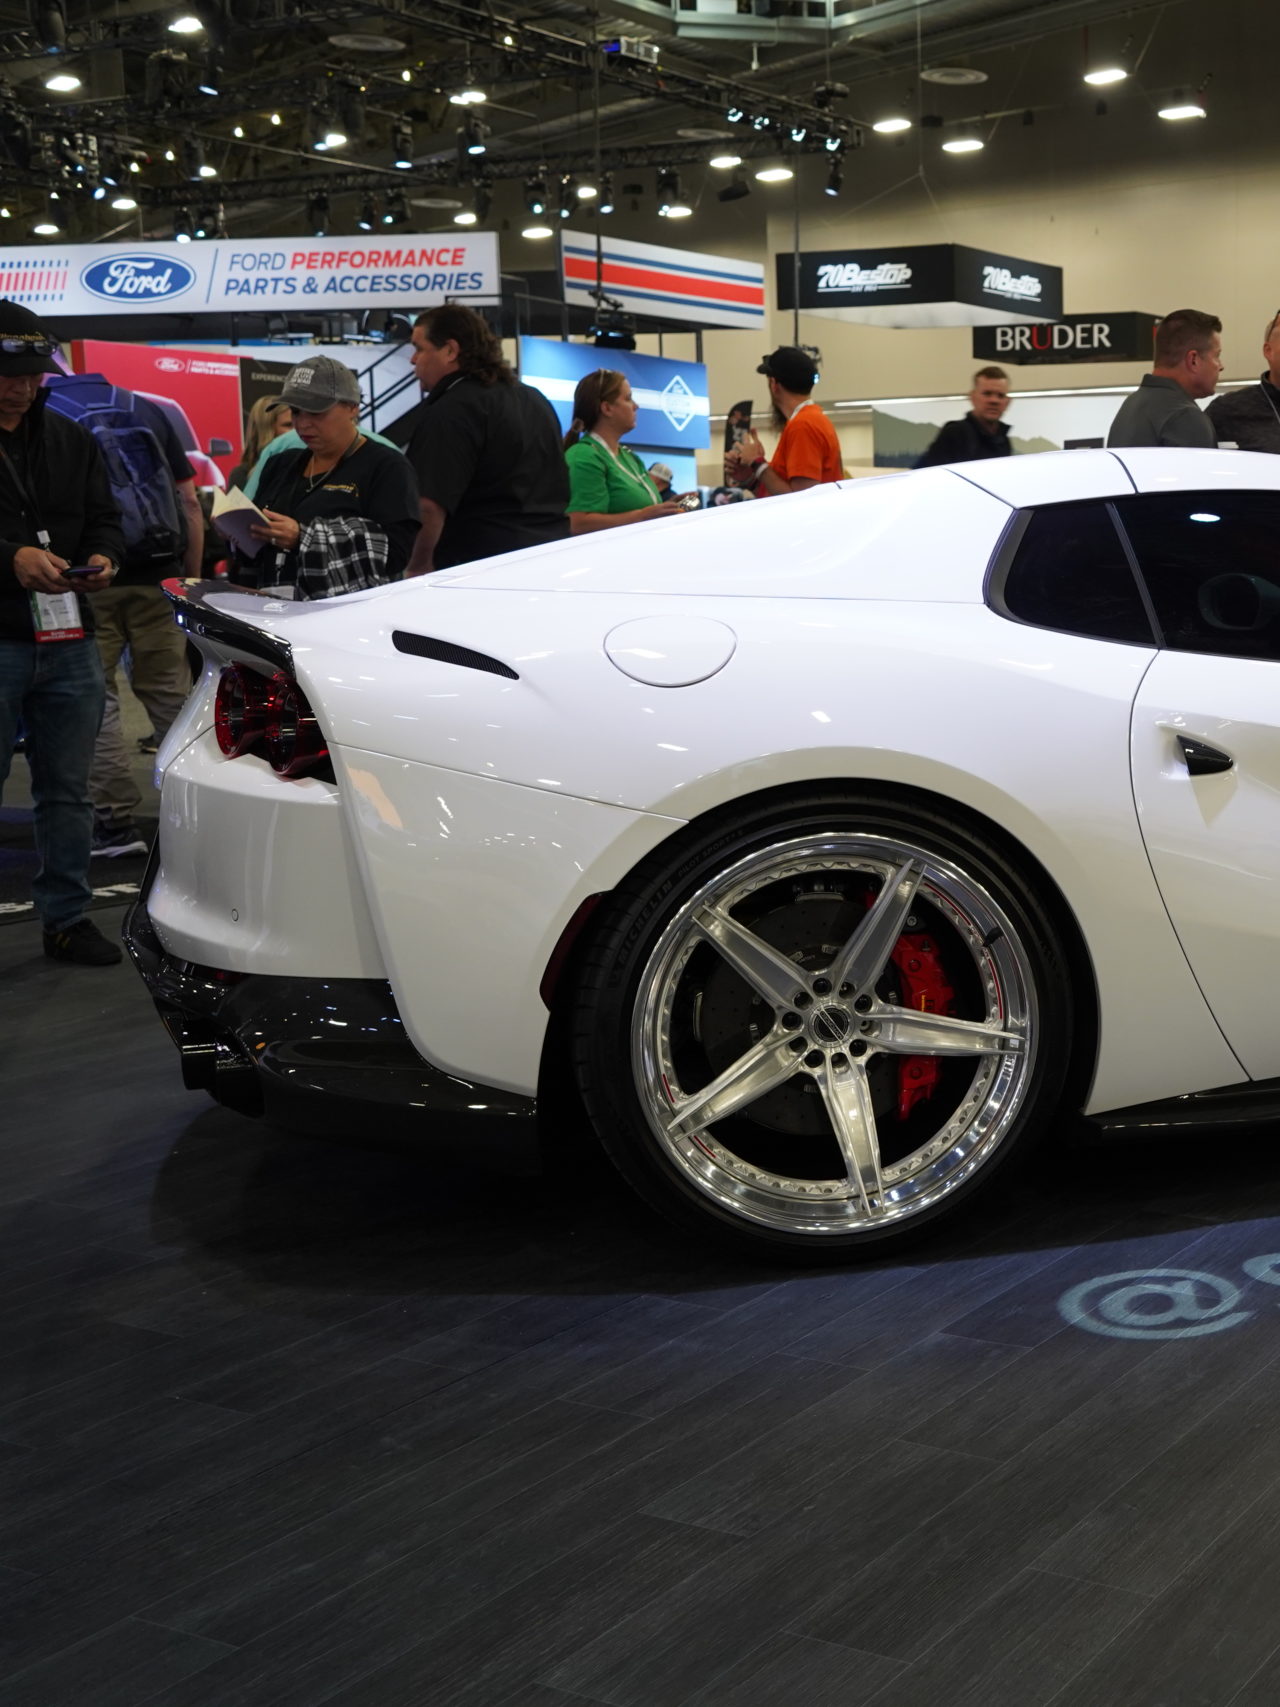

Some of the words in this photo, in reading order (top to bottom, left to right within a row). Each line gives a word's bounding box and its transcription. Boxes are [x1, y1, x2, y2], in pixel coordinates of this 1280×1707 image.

[229, 252, 285, 272] FORD
[290, 248, 466, 270] PERFORMANCE
[103, 260, 172, 295] Ford
[225, 277, 296, 296] PARTS
[302, 276, 318, 294] &
[323, 272, 483, 293] ACCESSORIES
